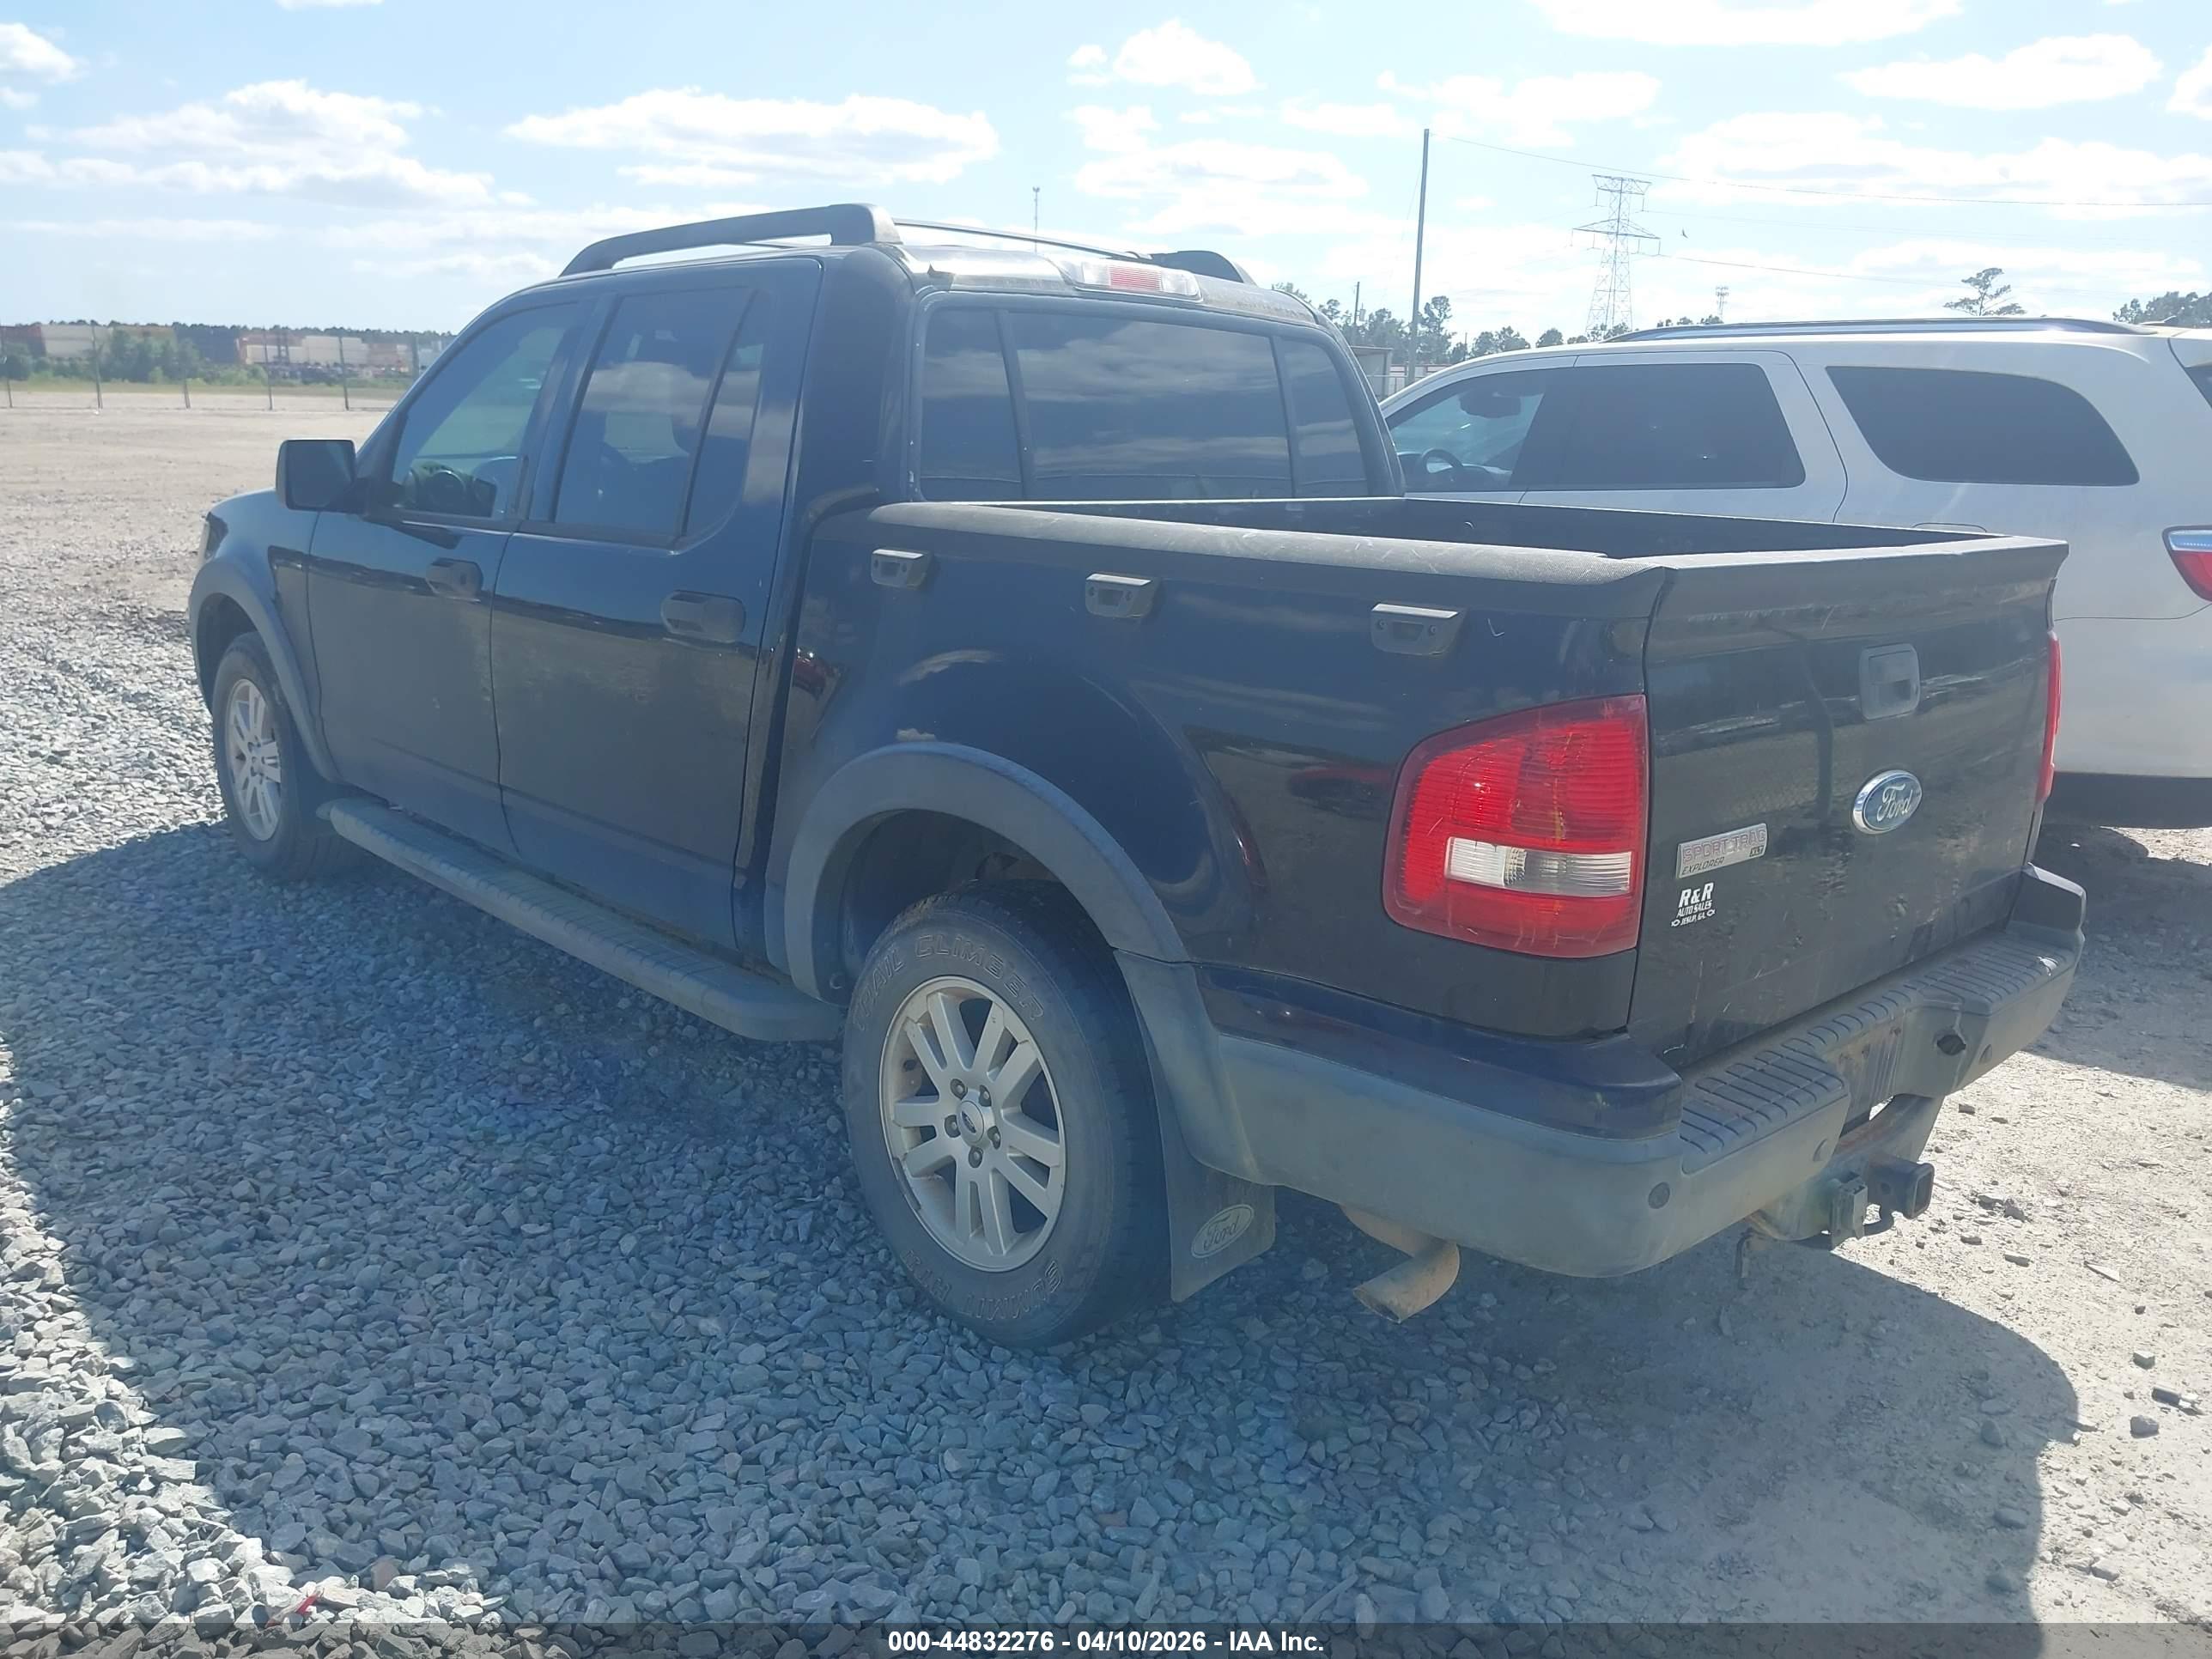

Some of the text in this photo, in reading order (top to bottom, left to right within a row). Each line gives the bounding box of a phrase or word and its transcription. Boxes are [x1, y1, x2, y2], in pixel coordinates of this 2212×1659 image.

[1876, 782, 1913, 822] Ford
[1683, 829, 1766, 863] SPORT TRAC
[1749, 845, 1765, 857] XLT
[1681, 856, 1725, 875] EXPLORER
[1676, 899, 1713, 918] AUTO SALES
[1678, 882, 1714, 908] R&R
[853, 933, 1045, 1031] TRAIL CLIMBER
[1203, 1213, 1241, 1251] Ford
